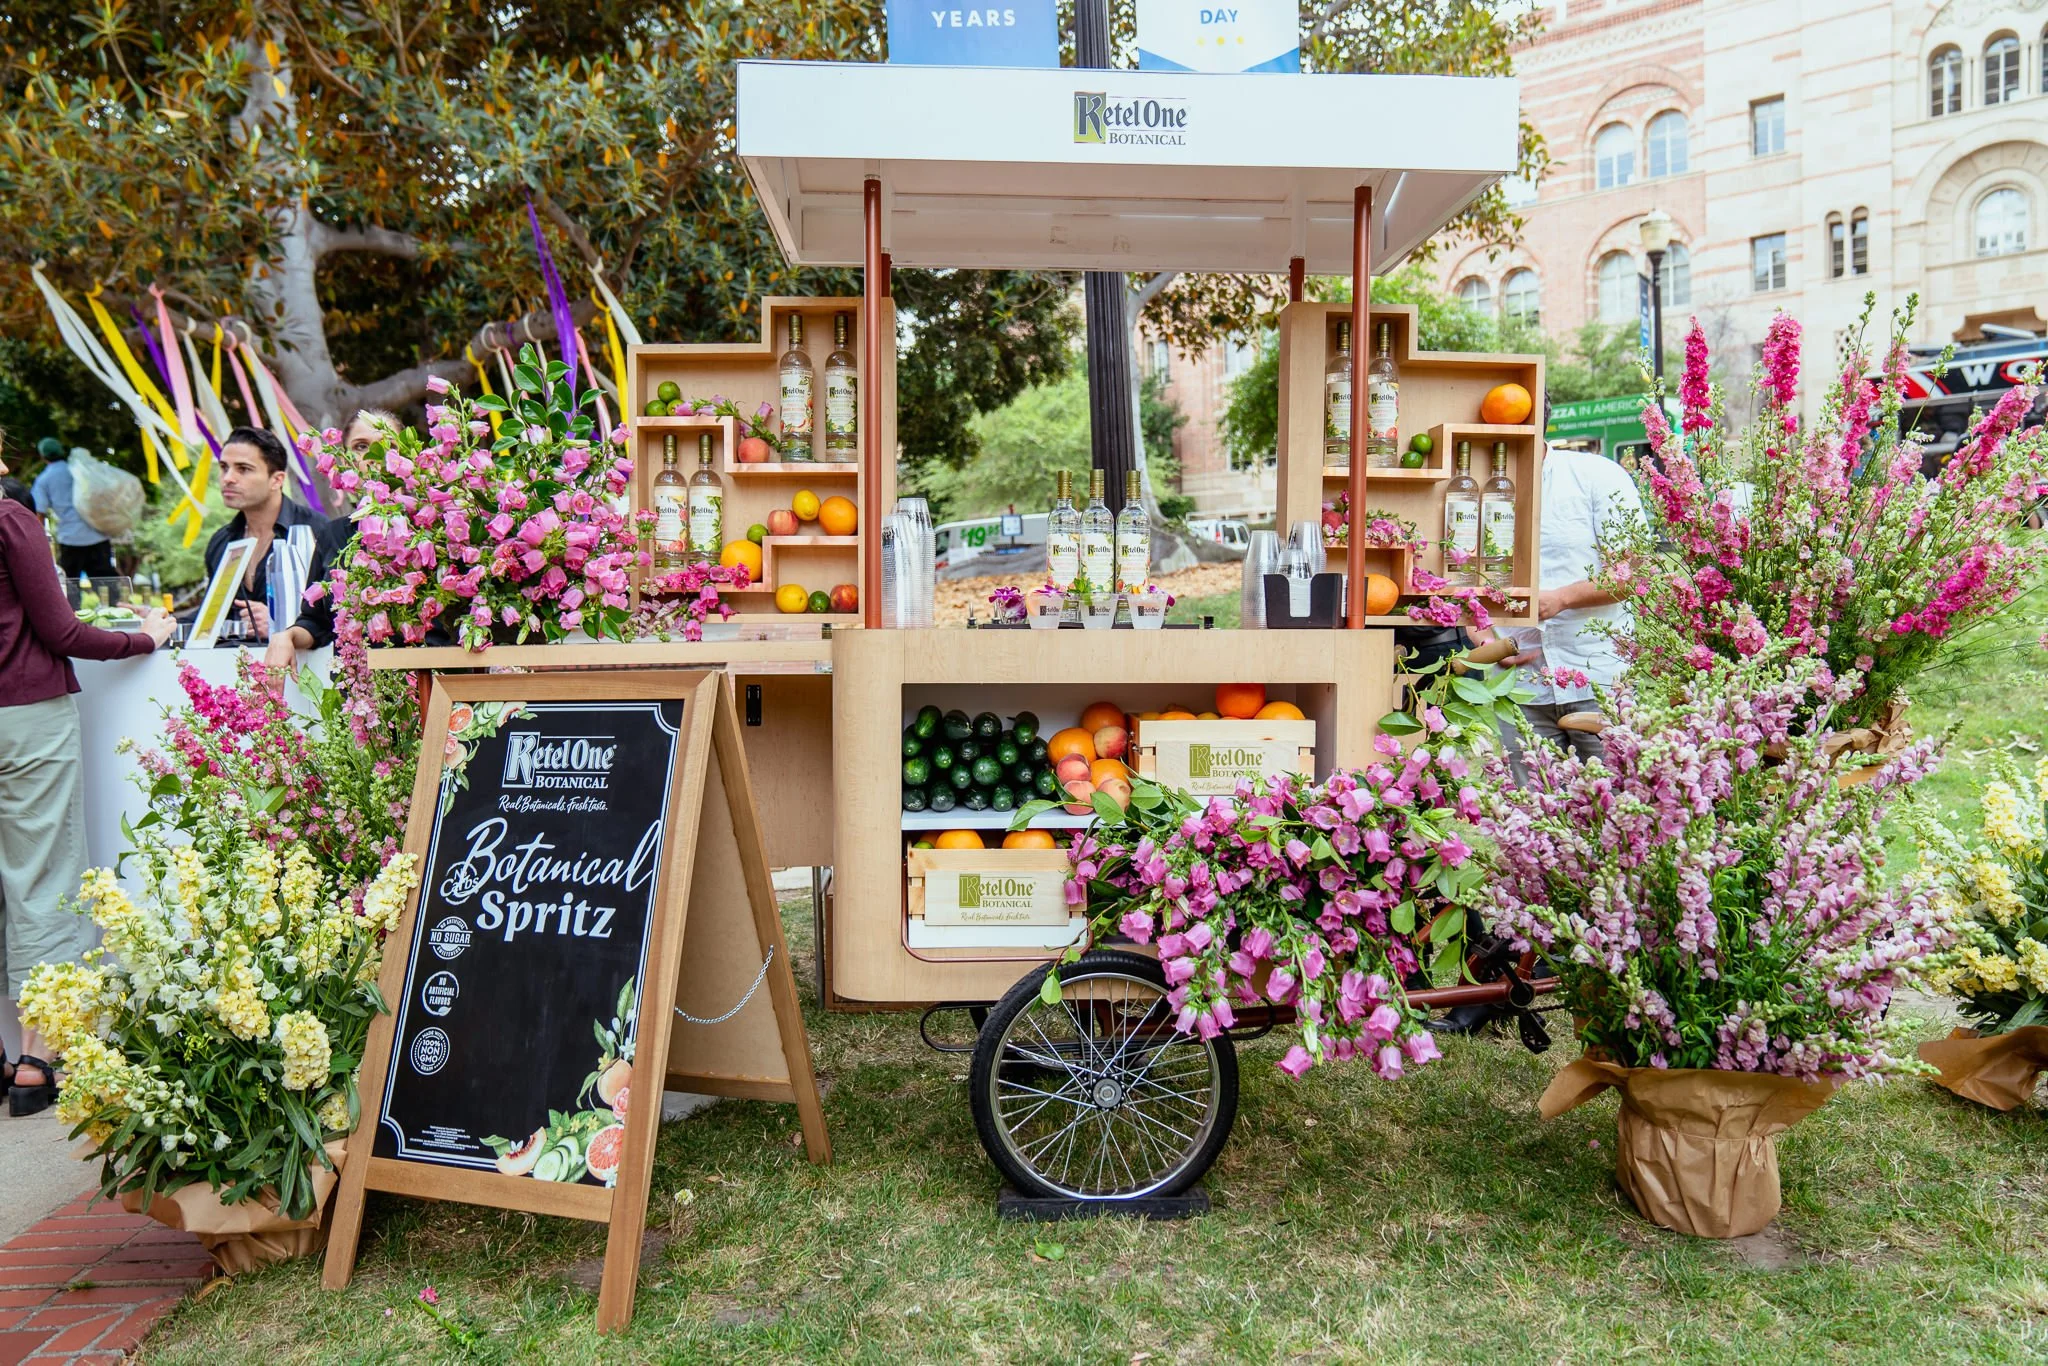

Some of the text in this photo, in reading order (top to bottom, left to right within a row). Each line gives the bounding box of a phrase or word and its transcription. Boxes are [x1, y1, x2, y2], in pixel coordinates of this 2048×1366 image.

[931, 9, 1016, 28] YEARS
[1200, 9, 1239, 25] DAY
[1075, 95, 1187, 140] Ketel One
[1109, 132, 1186, 145] BOTANICAL
[1551, 407, 1577, 419] ZZA
[1593, 399, 1645, 415] AMERIC
[506, 735, 615, 785] Ketel One
[1190, 746, 1263, 776] Ketel One
[535, 775, 609, 789] BOTANICAL
[498, 795, 522, 813] Real
[453, 817, 662, 898] Botanical
[961, 876, 1034, 906] Ketel One
[982, 900, 1033, 908] BOTANICAL
[477, 890, 617, 942] Spritz
[431, 931, 471, 944] NO SUGAR
[439, 977, 447, 985] NO
[428, 986, 455, 996] ARTIFICIAL
[428, 996, 451, 1006] FLAVORS
[422, 1039, 440, 1047] 100%
[420, 1046, 440, 1056] NON
[419, 1054, 438, 1064] GMO
